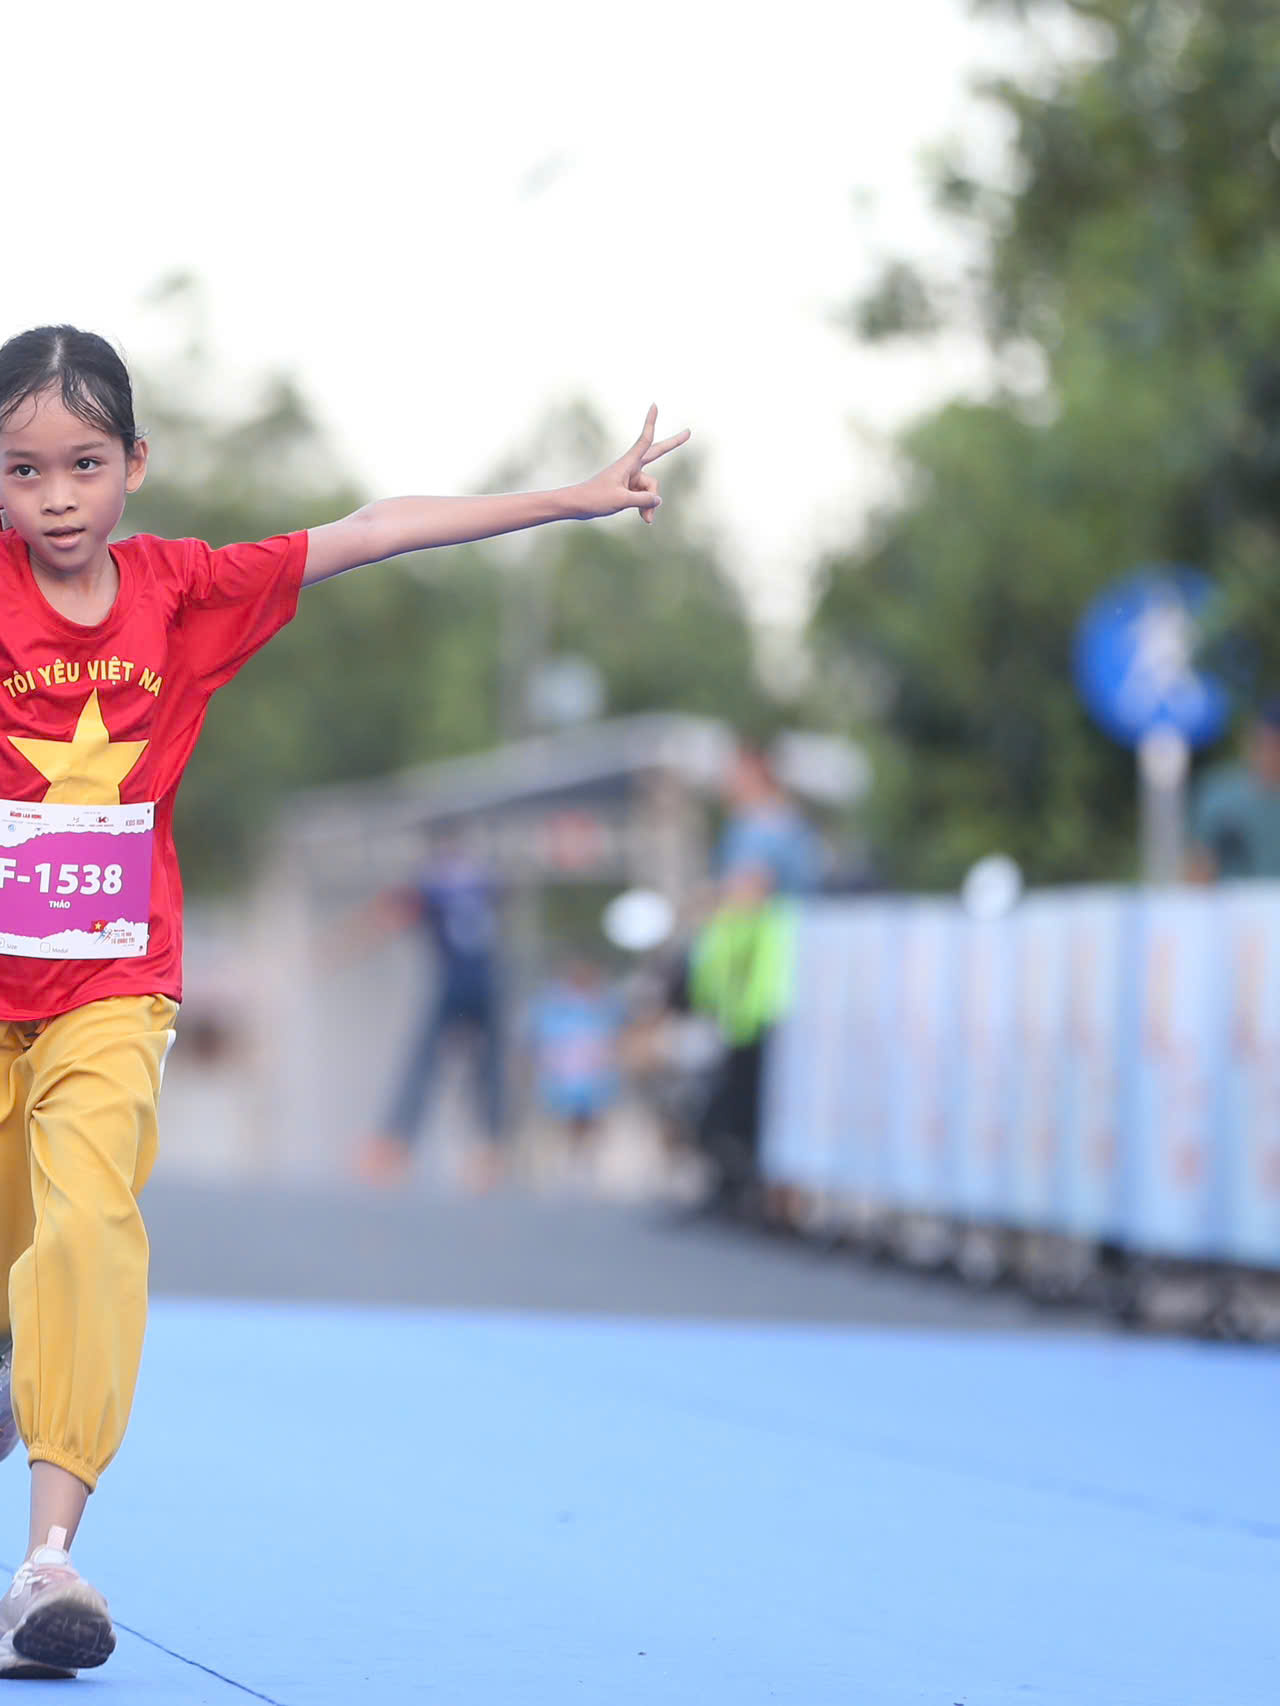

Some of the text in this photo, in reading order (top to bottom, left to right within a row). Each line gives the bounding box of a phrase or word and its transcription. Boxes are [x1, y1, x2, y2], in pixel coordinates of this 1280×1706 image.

[2, 670, 36, 698] TÔI
[37, 658, 80, 687] YÊU
[87, 655, 135, 686] VIỆT
